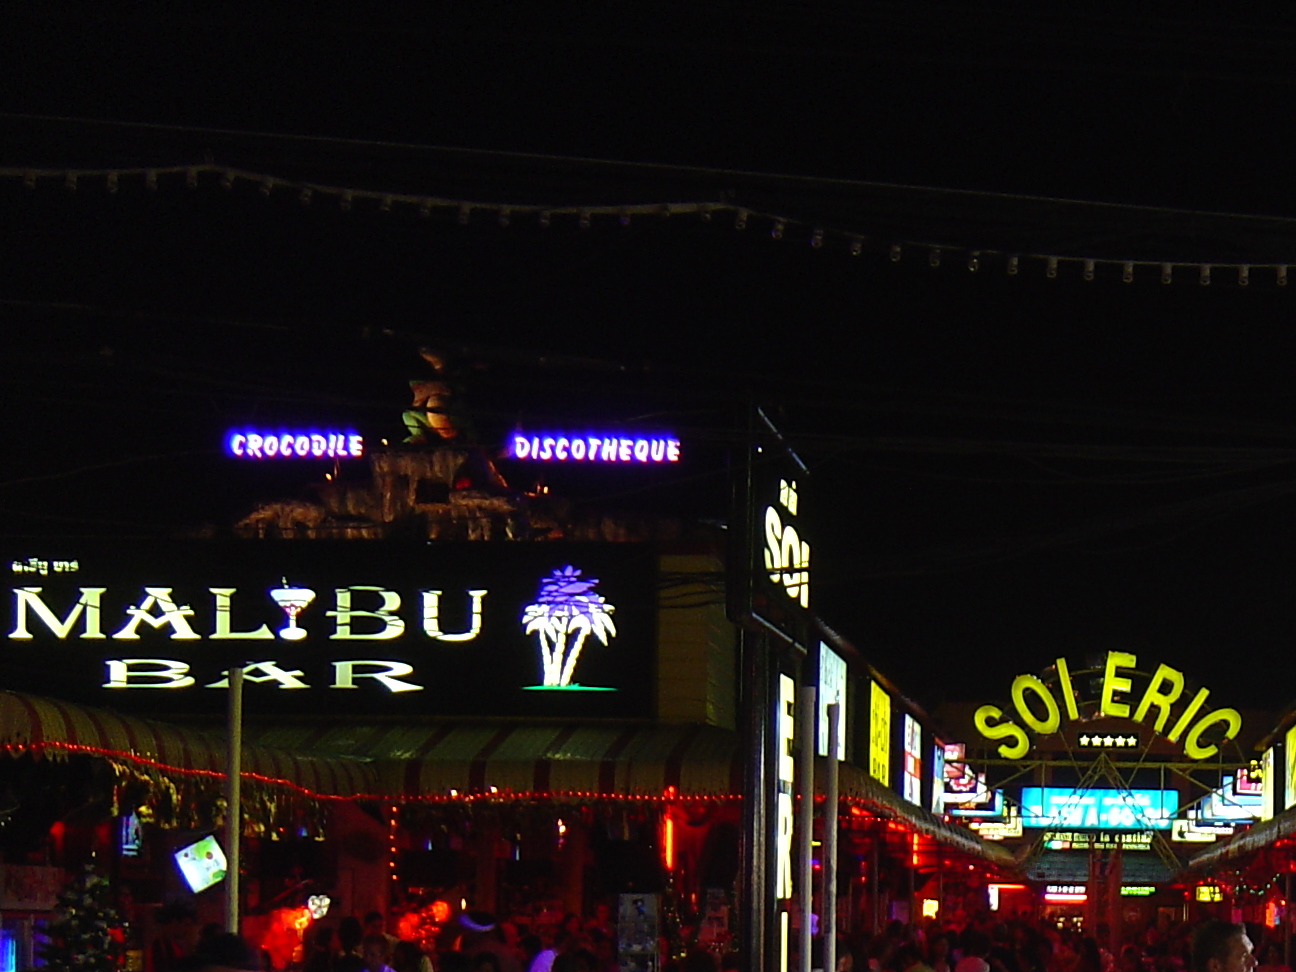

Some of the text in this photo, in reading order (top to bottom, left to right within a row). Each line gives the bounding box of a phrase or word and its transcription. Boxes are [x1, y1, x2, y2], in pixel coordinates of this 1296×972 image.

[230, 432, 682, 463] CROCODILE DISCOTHEQUE
[763, 505, 811, 609] SOI
[8, 585, 488, 641] MALIBU
[100, 657, 425, 692] BAR
[974, 657, 1079, 760] SOI
[1101, 652, 1242, 760] ERIC
